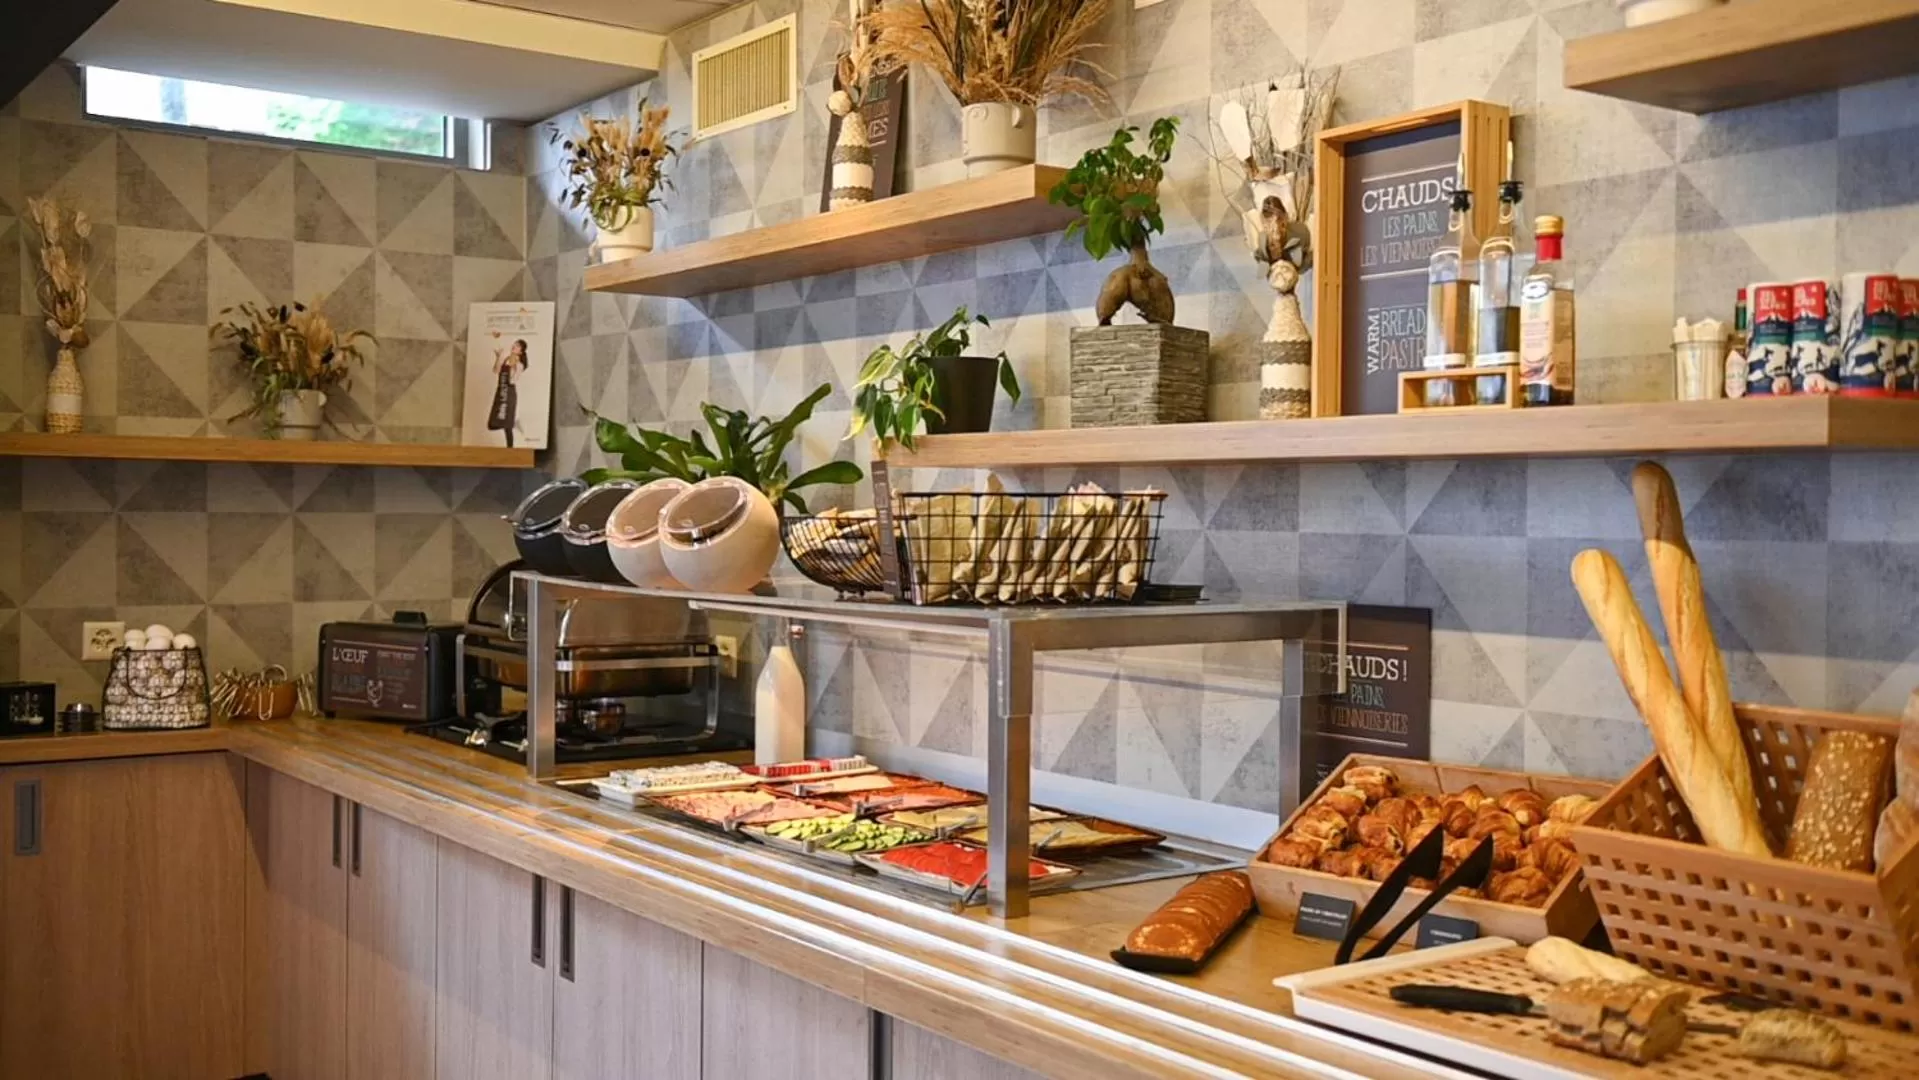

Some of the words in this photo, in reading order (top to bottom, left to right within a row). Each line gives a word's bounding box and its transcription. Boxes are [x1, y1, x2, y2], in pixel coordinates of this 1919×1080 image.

[1361, 176, 1455, 214] CHAUDS
[1382, 216, 1400, 239] LES
[1403, 210, 1439, 236] PAINS
[1360, 245, 1377, 267] LES
[1381, 336, 1426, 370] PASTR
